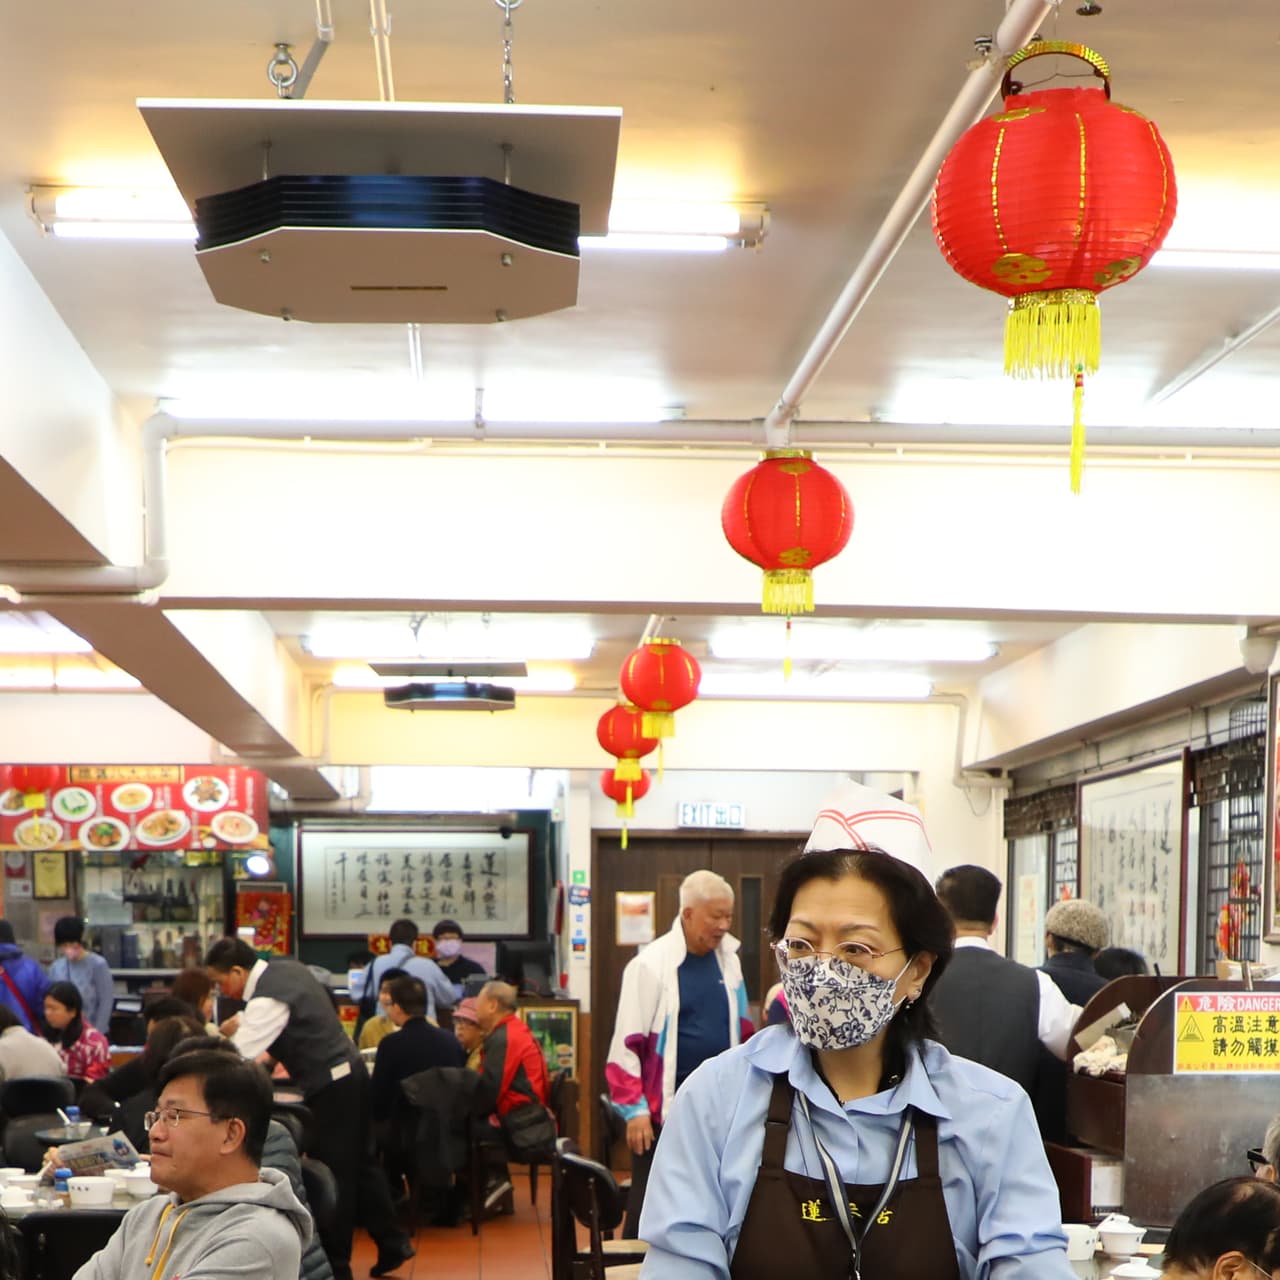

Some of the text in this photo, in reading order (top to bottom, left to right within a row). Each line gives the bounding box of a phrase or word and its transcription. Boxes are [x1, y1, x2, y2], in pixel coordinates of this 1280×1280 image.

[682, 803, 741, 825] EXIT 出口
[1196, 996, 1236, 1012] 危險
[1212, 1015, 1279, 1034] 高溫注意
[1212, 1037, 1279, 1057] 請勿觸摸
